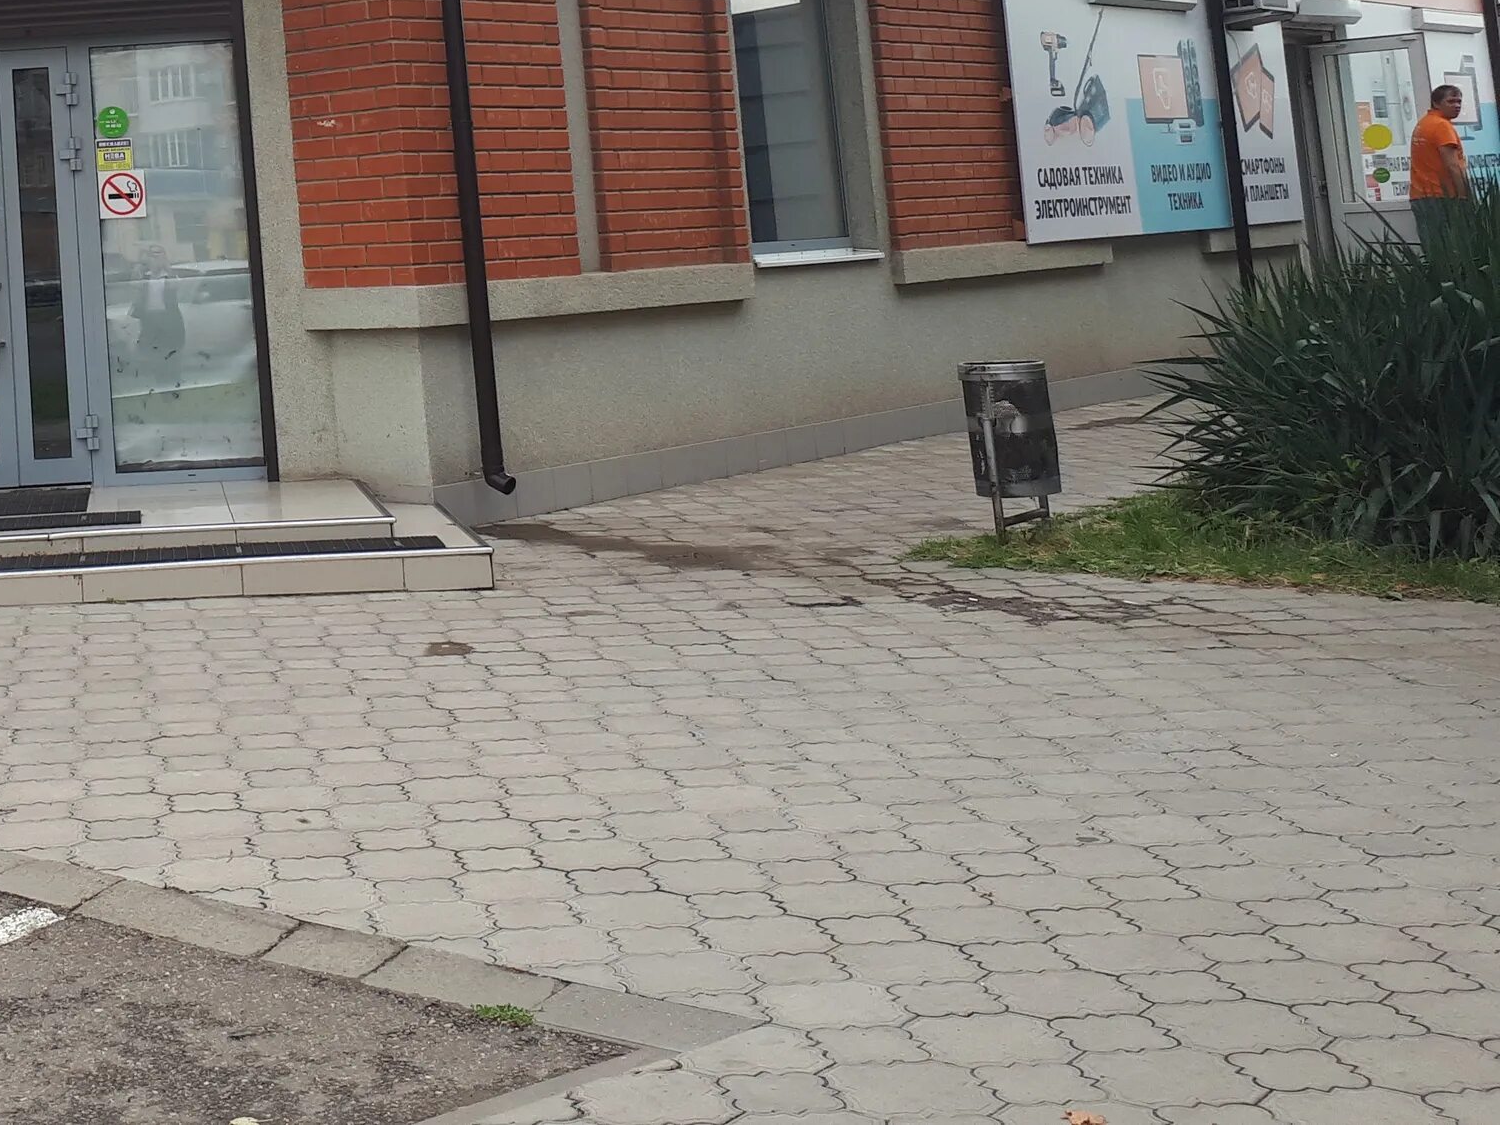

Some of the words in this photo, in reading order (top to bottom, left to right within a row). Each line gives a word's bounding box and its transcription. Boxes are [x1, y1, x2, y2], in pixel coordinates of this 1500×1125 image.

[1150, 163, 1178, 185] ВИДЕО
[1178, 163, 1186, 182] И
[1187, 162, 1212, 184] АУДИО
[1240, 156, 1286, 176] СМАРТФОНЫ
[1037, 166, 1082, 190] САДОВАЯ
[1082, 165, 1124, 186] ТЕХНИКА
[1167, 190, 1205, 212] ТЕХНИКА
[1249, 183, 1289, 202] ПЛАНШЕТЫ
[1034, 194, 1132, 220] ЭЛЕКТРОИНСТРУМЕНТ
